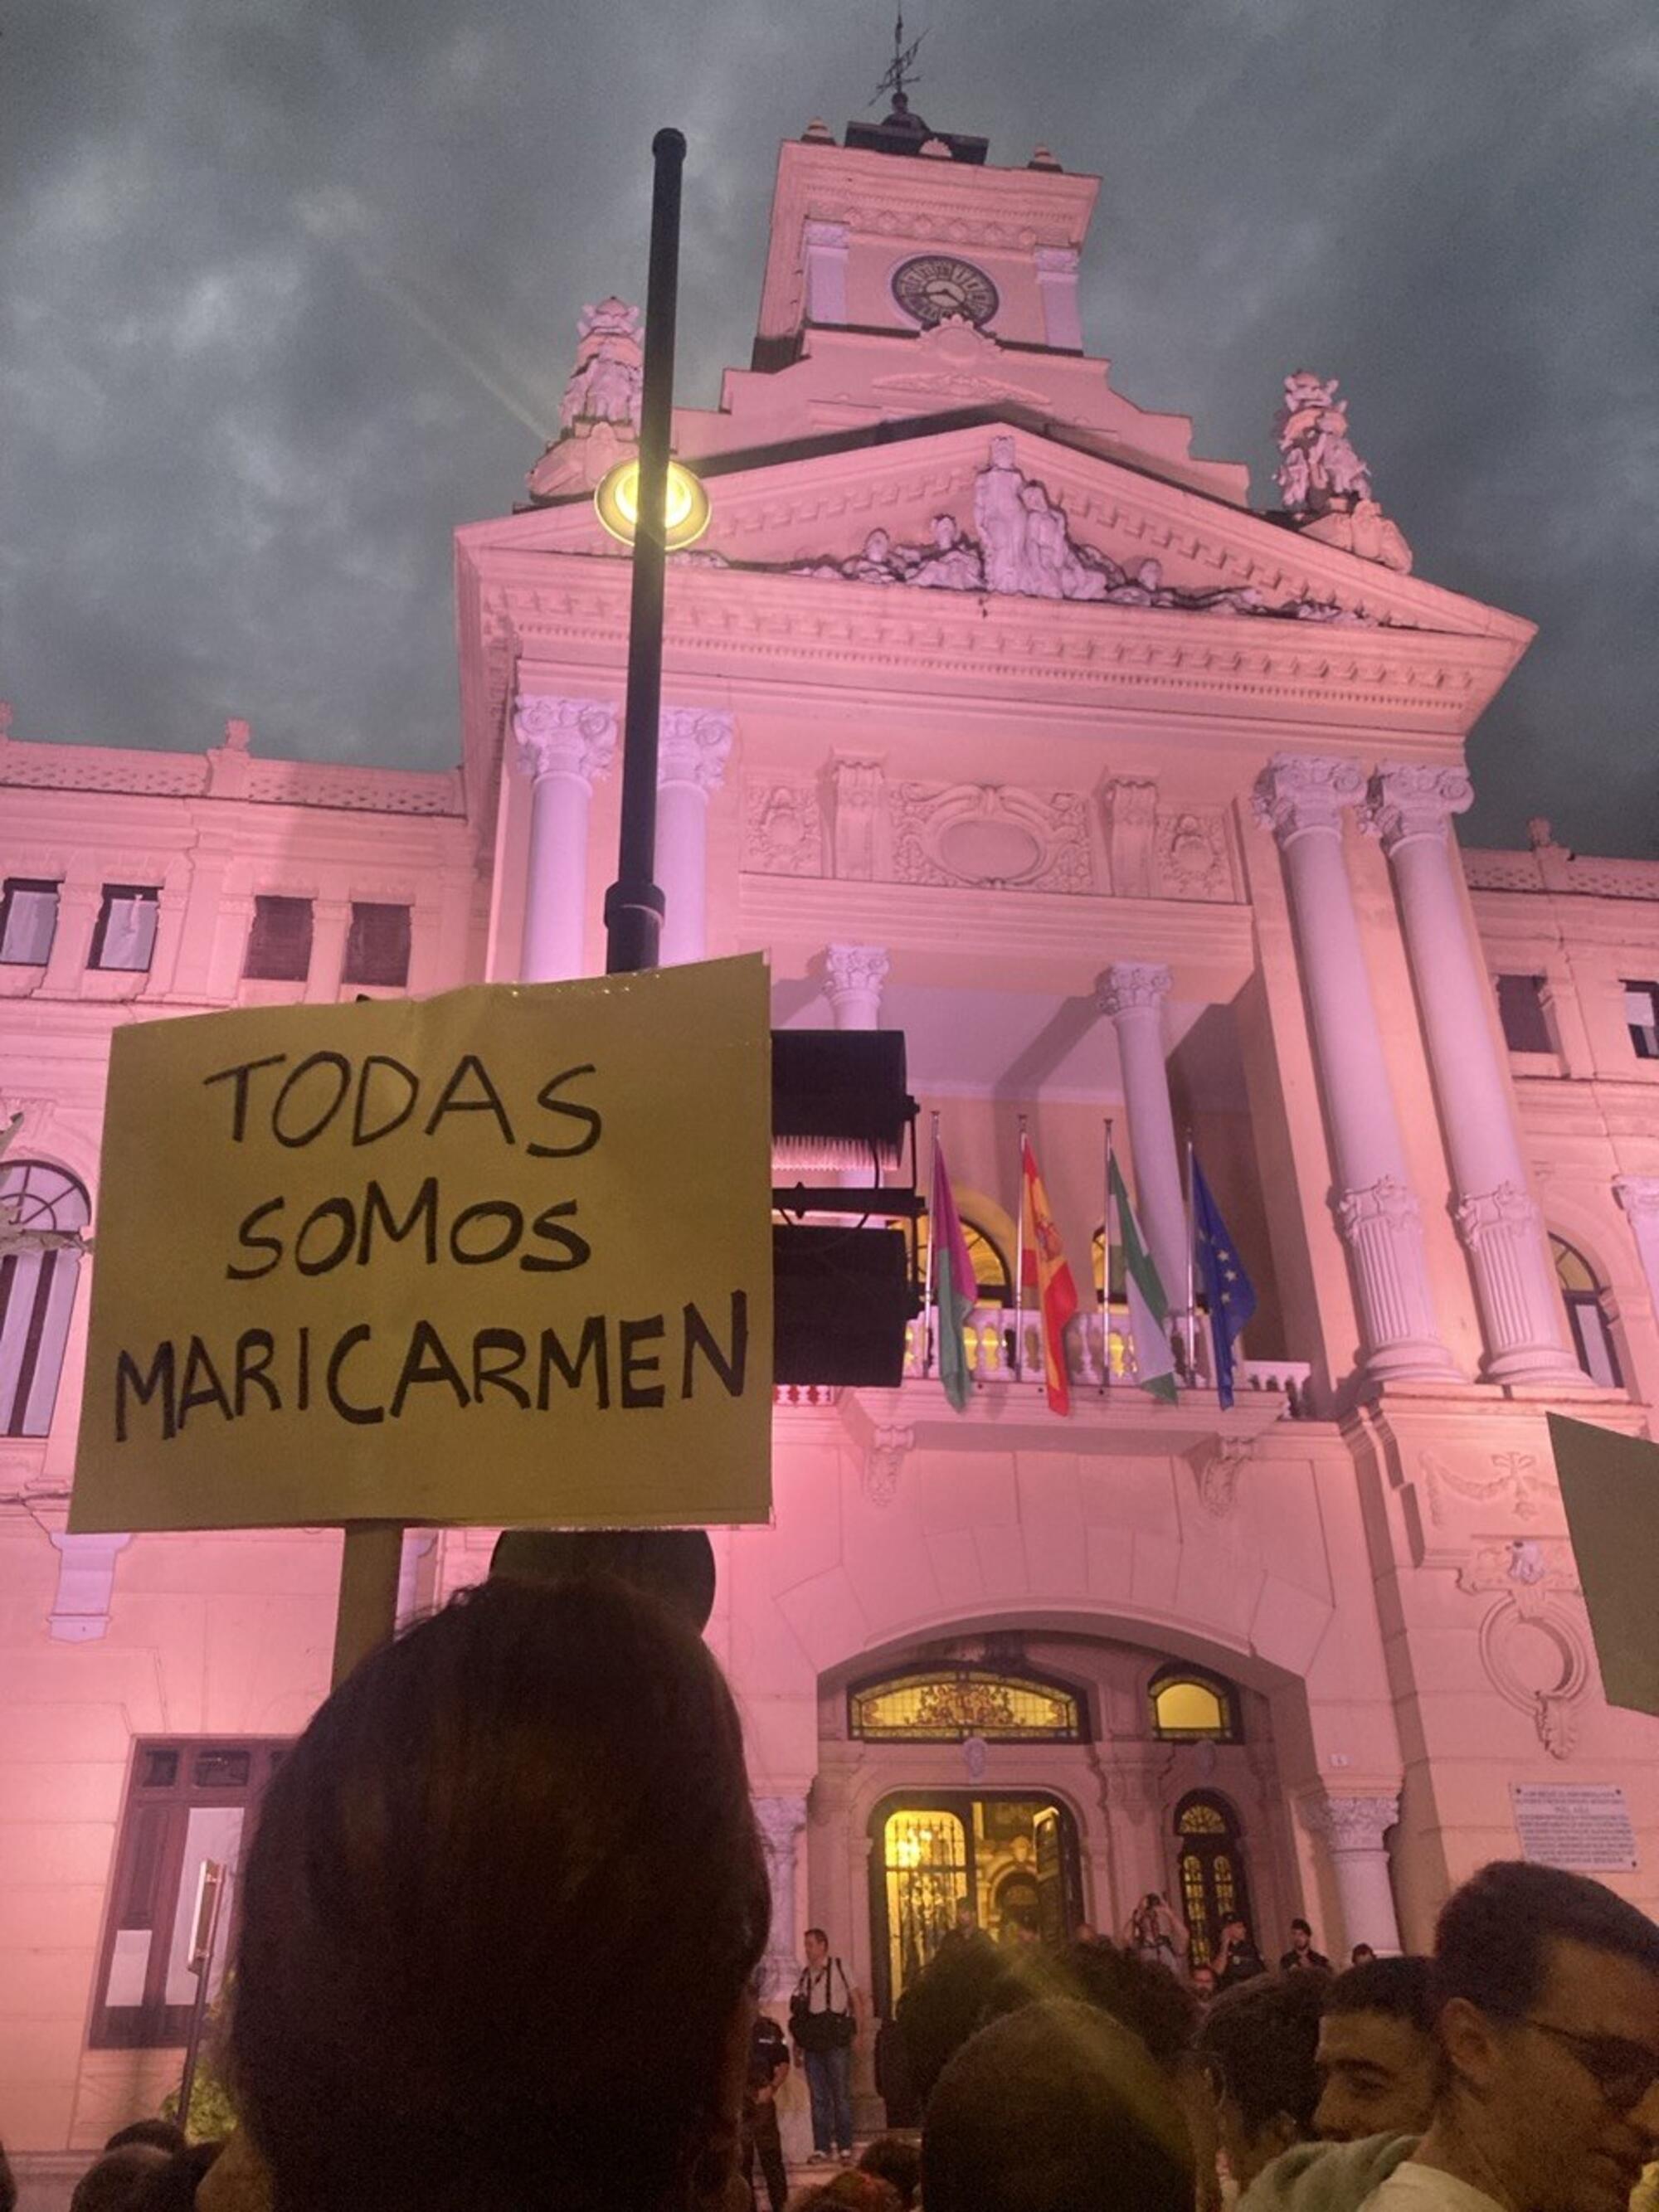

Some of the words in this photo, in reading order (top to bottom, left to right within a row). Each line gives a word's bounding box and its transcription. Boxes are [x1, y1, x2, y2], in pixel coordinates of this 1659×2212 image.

[203, 1051, 602, 1158] TODAS
[226, 1177, 591, 1281] SOMOS
[115, 1289, 750, 1442] MARICARMEN
